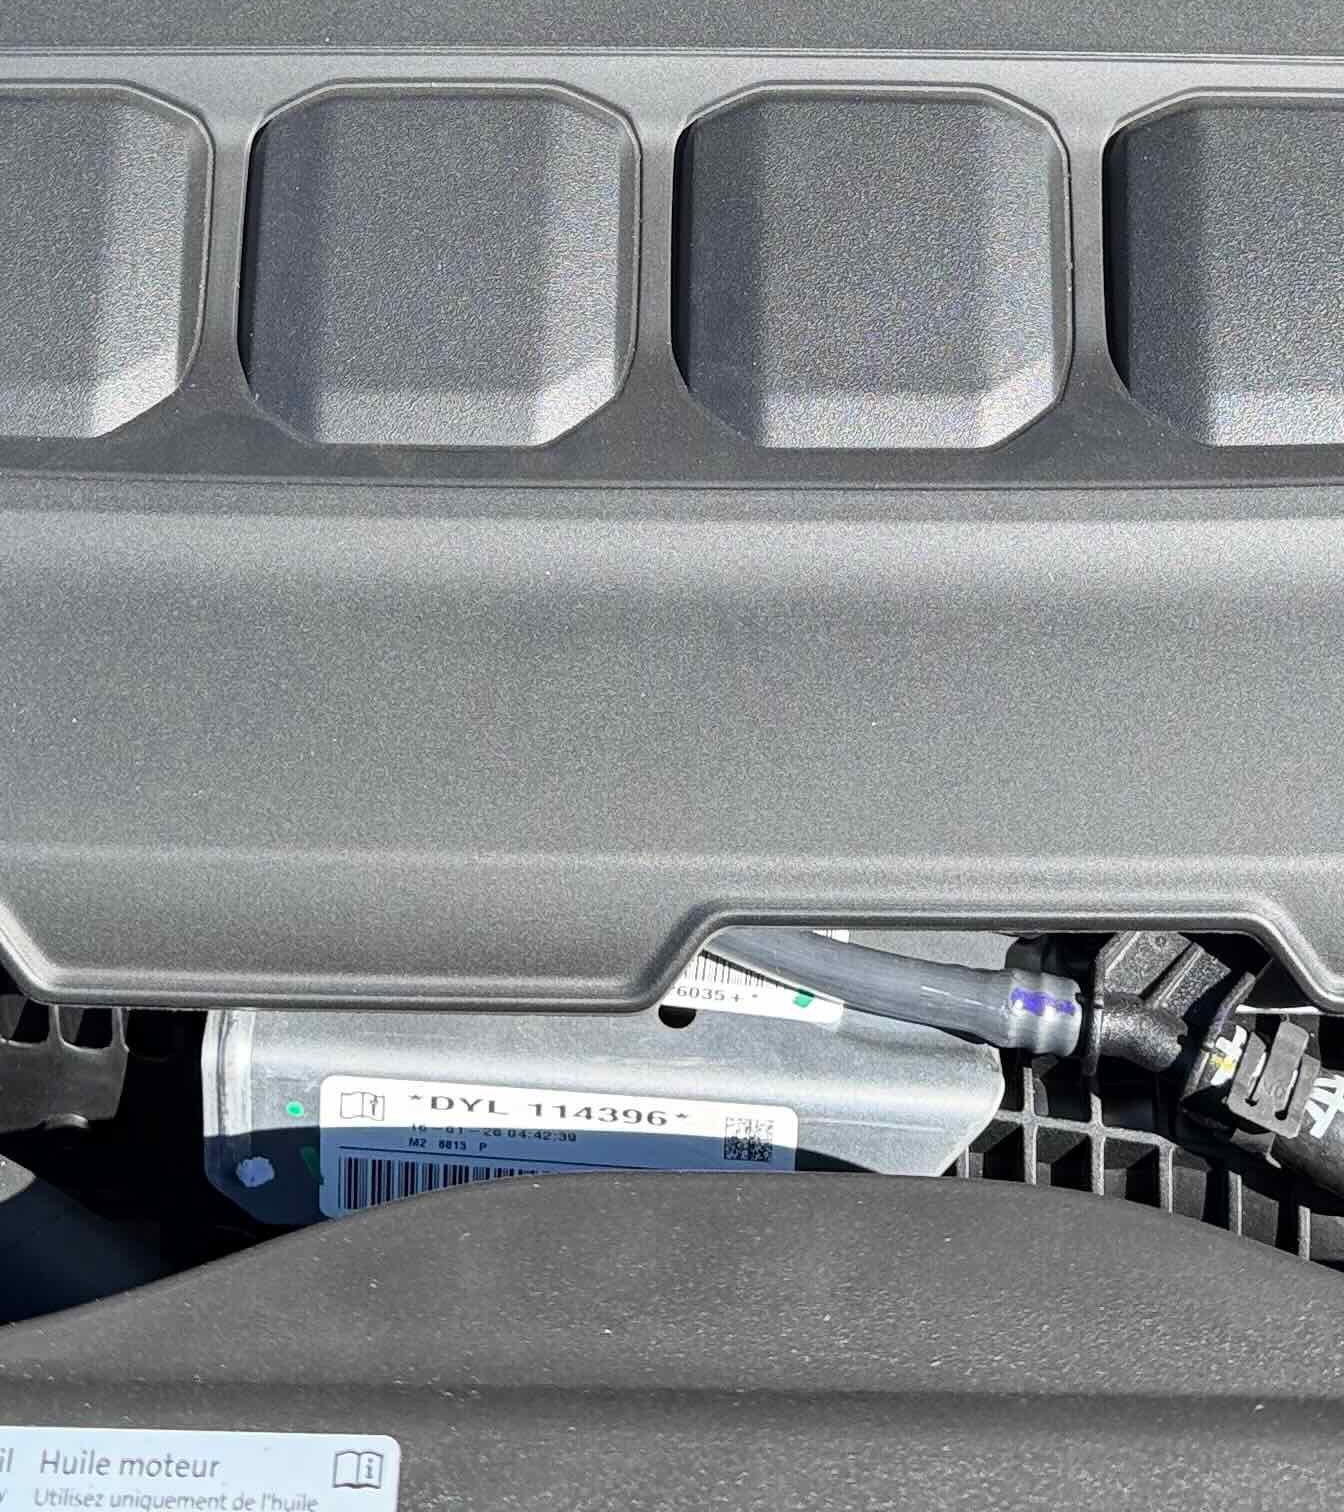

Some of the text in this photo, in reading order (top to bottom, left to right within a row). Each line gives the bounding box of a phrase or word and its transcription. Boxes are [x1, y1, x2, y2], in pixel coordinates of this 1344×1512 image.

[39, 1448, 221, 1479] Huile moteur
[33, 1488, 320, 1512] Utilisez uniquement de l'huile
